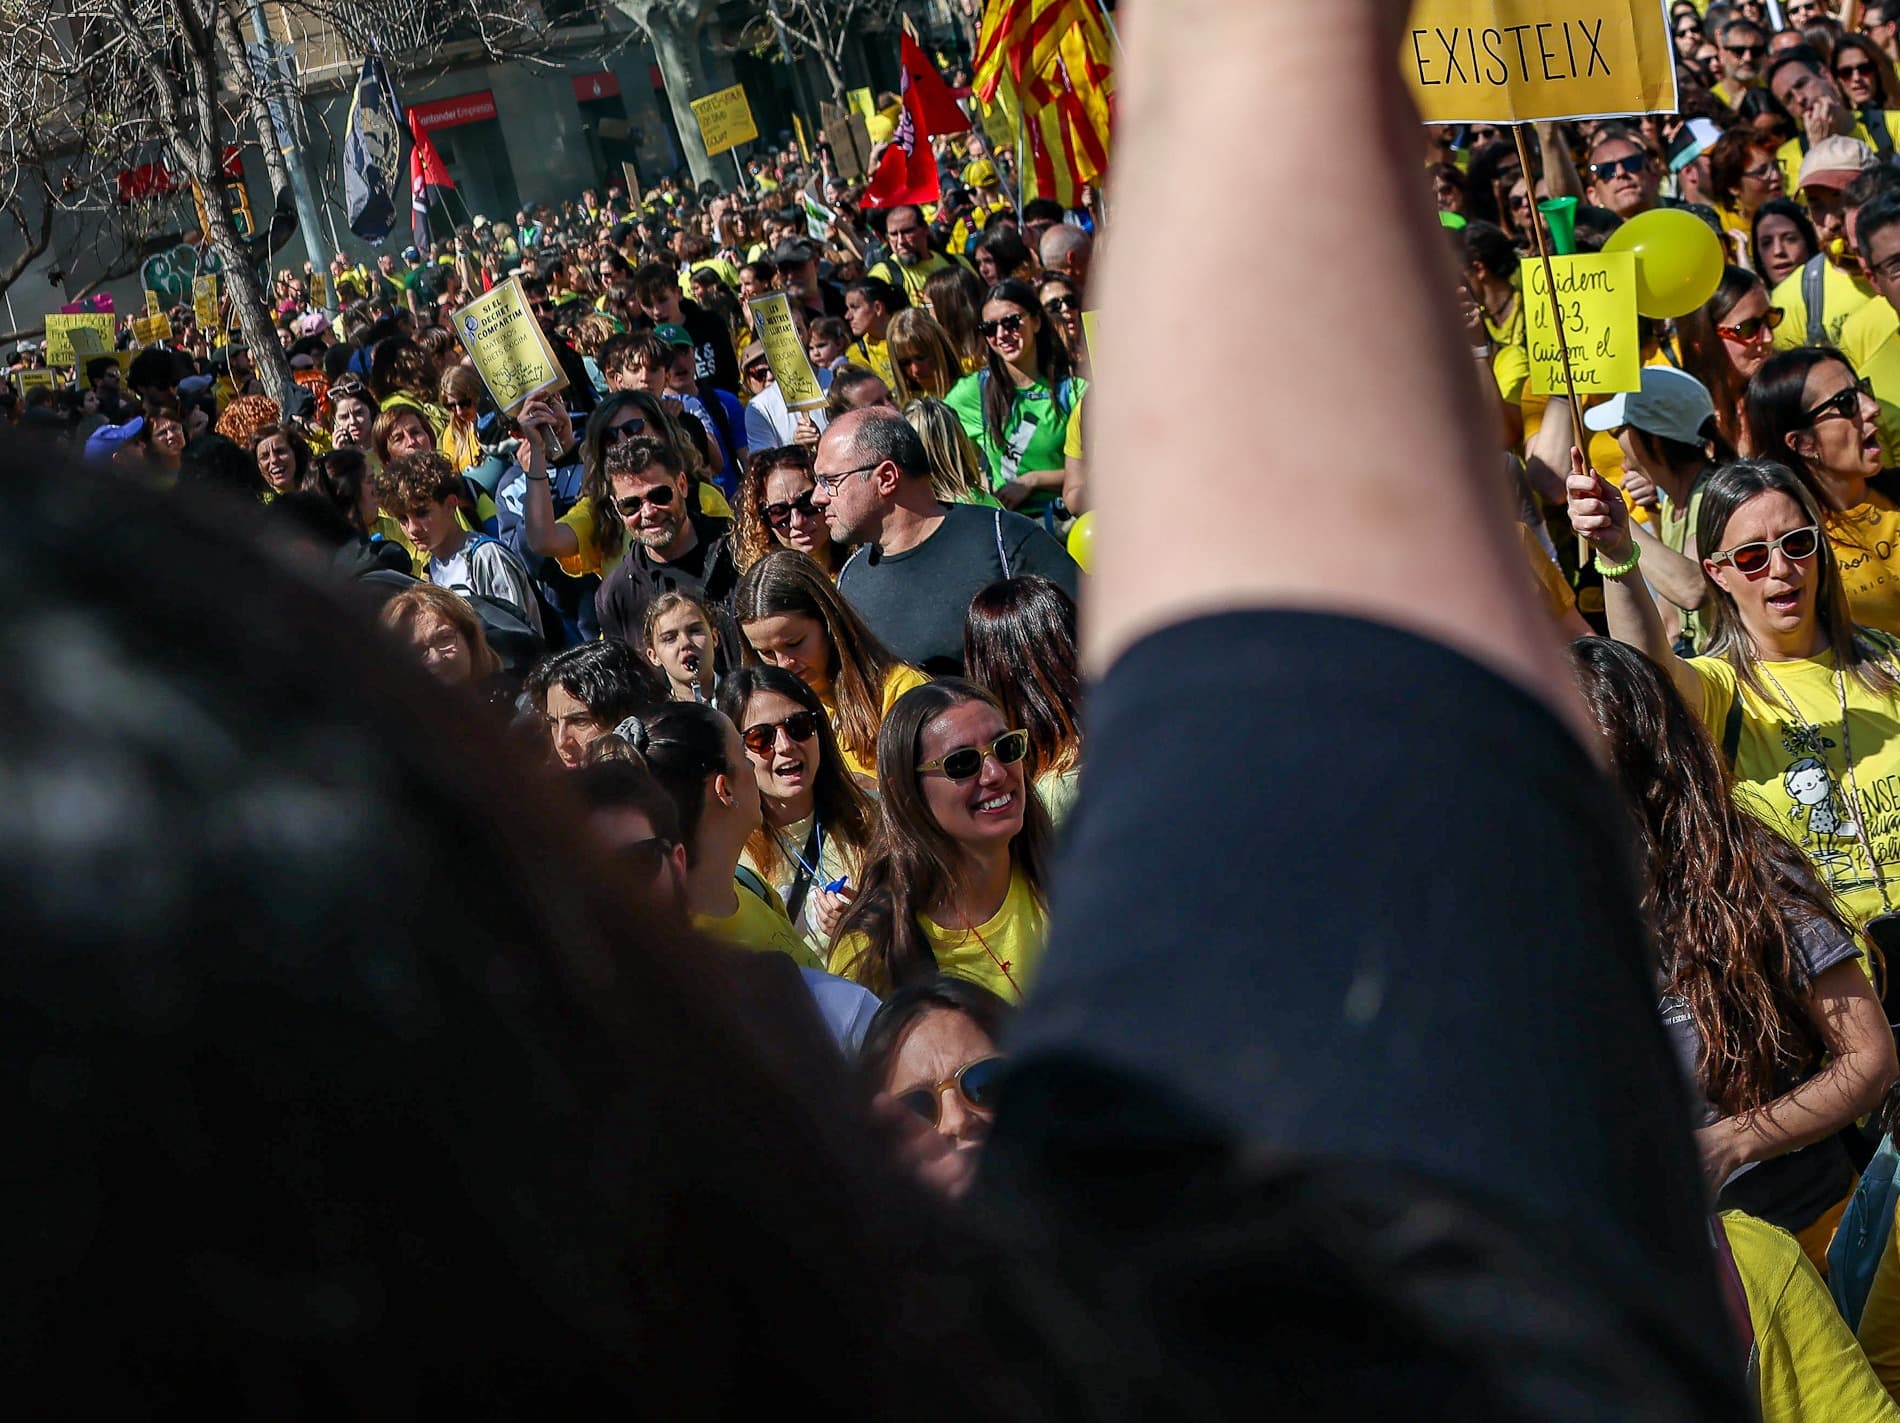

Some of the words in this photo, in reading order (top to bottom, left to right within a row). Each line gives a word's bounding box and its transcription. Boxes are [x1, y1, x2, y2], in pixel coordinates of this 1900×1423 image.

[1412, 18, 1612, 86] EXISTEIX
[418, 110, 456, 127] antander
[1531, 261, 1616, 296] Cuidem
[477, 308, 524, 341] COMPARTIM
[481, 303, 511, 327] DECRET
[1534, 302, 1549, 329] el
[1532, 341, 1590, 363] Cuidm
[1596, 326, 1616, 358] el
[1546, 363, 1602, 392] fuur
